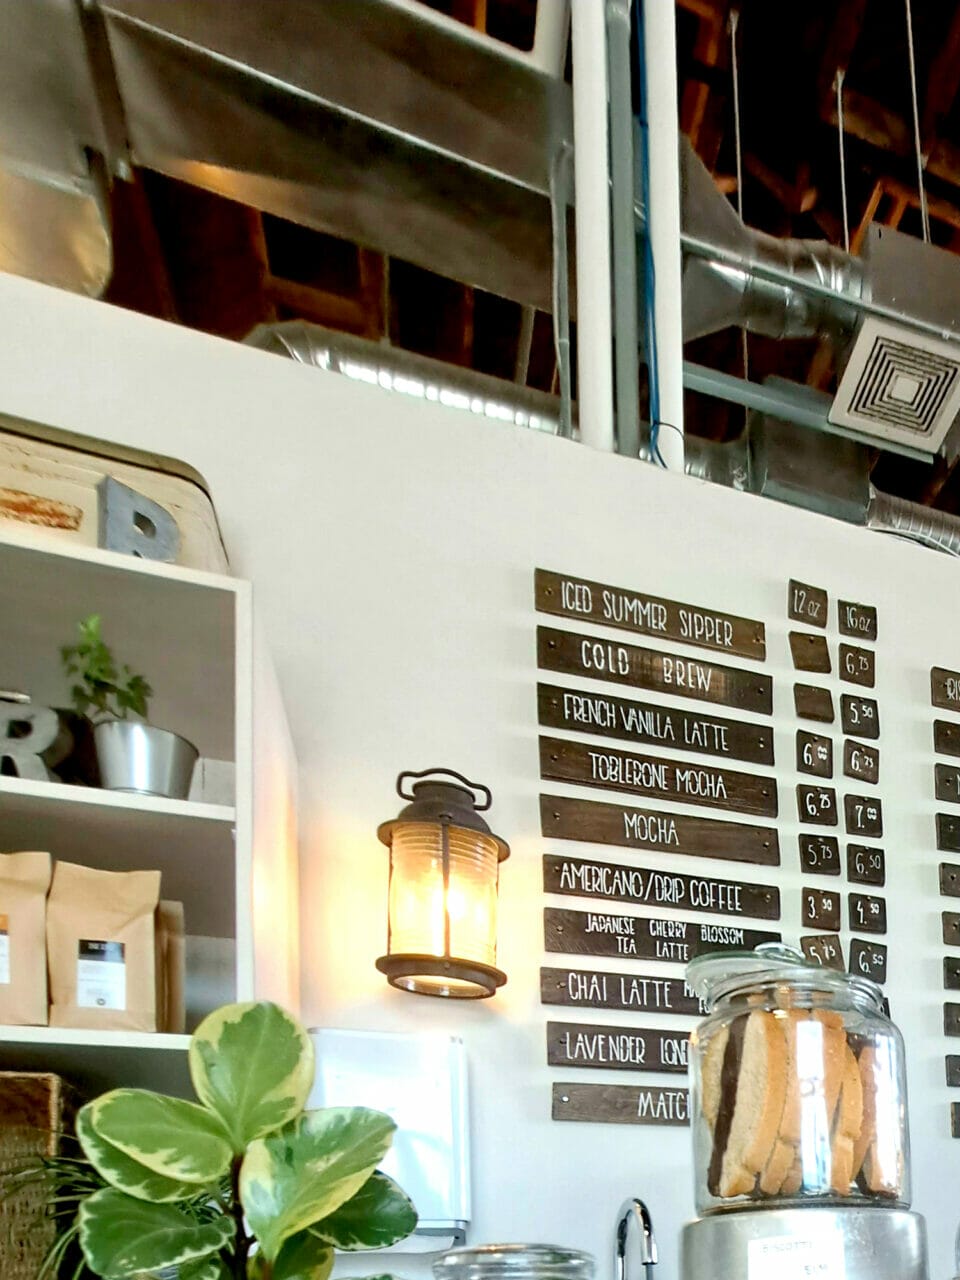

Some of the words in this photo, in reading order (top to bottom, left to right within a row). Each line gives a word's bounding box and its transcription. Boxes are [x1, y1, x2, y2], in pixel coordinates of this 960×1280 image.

[562, 581, 593, 613] ICED
[603, 591, 667, 631] SUMMER
[680, 609, 734, 647] SIPPER
[793, 589, 806, 613] 12
[846, 606, 858, 629] 16
[581, 640, 629, 675] COLD
[664, 658, 712, 692] BREW
[845, 652, 869, 675] 6.75
[563, 693, 617, 729] FRENCH
[620, 706, 675, 741] VANILLA
[684, 722, 729, 751] LATTE
[850, 702, 873, 724] 5.50
[588, 752, 670, 793] TOBLERONE
[676, 769, 727, 799] MOCHA
[624, 812, 680, 845] MOCHA
[808, 845, 832, 866] 5.75
[855, 852, 881, 875] 6.50
[560, 863, 684, 904] AMERICANO/DRIP
[690, 880, 743, 912] COFFEE
[808, 896, 832, 918] 3.50
[857, 901, 880, 924] 4.50
[585, 914, 635, 936] JAPANESE
[649, 920, 687, 939] CHERRY
[701, 925, 744, 945] BLOSSOM
[616, 936, 637, 954] TEA
[656, 941, 689, 961] LATTE
[568, 972, 607, 1001] CHAI
[621, 977, 673, 1008] LATTE
[565, 1031, 647, 1064] LAVENDER
